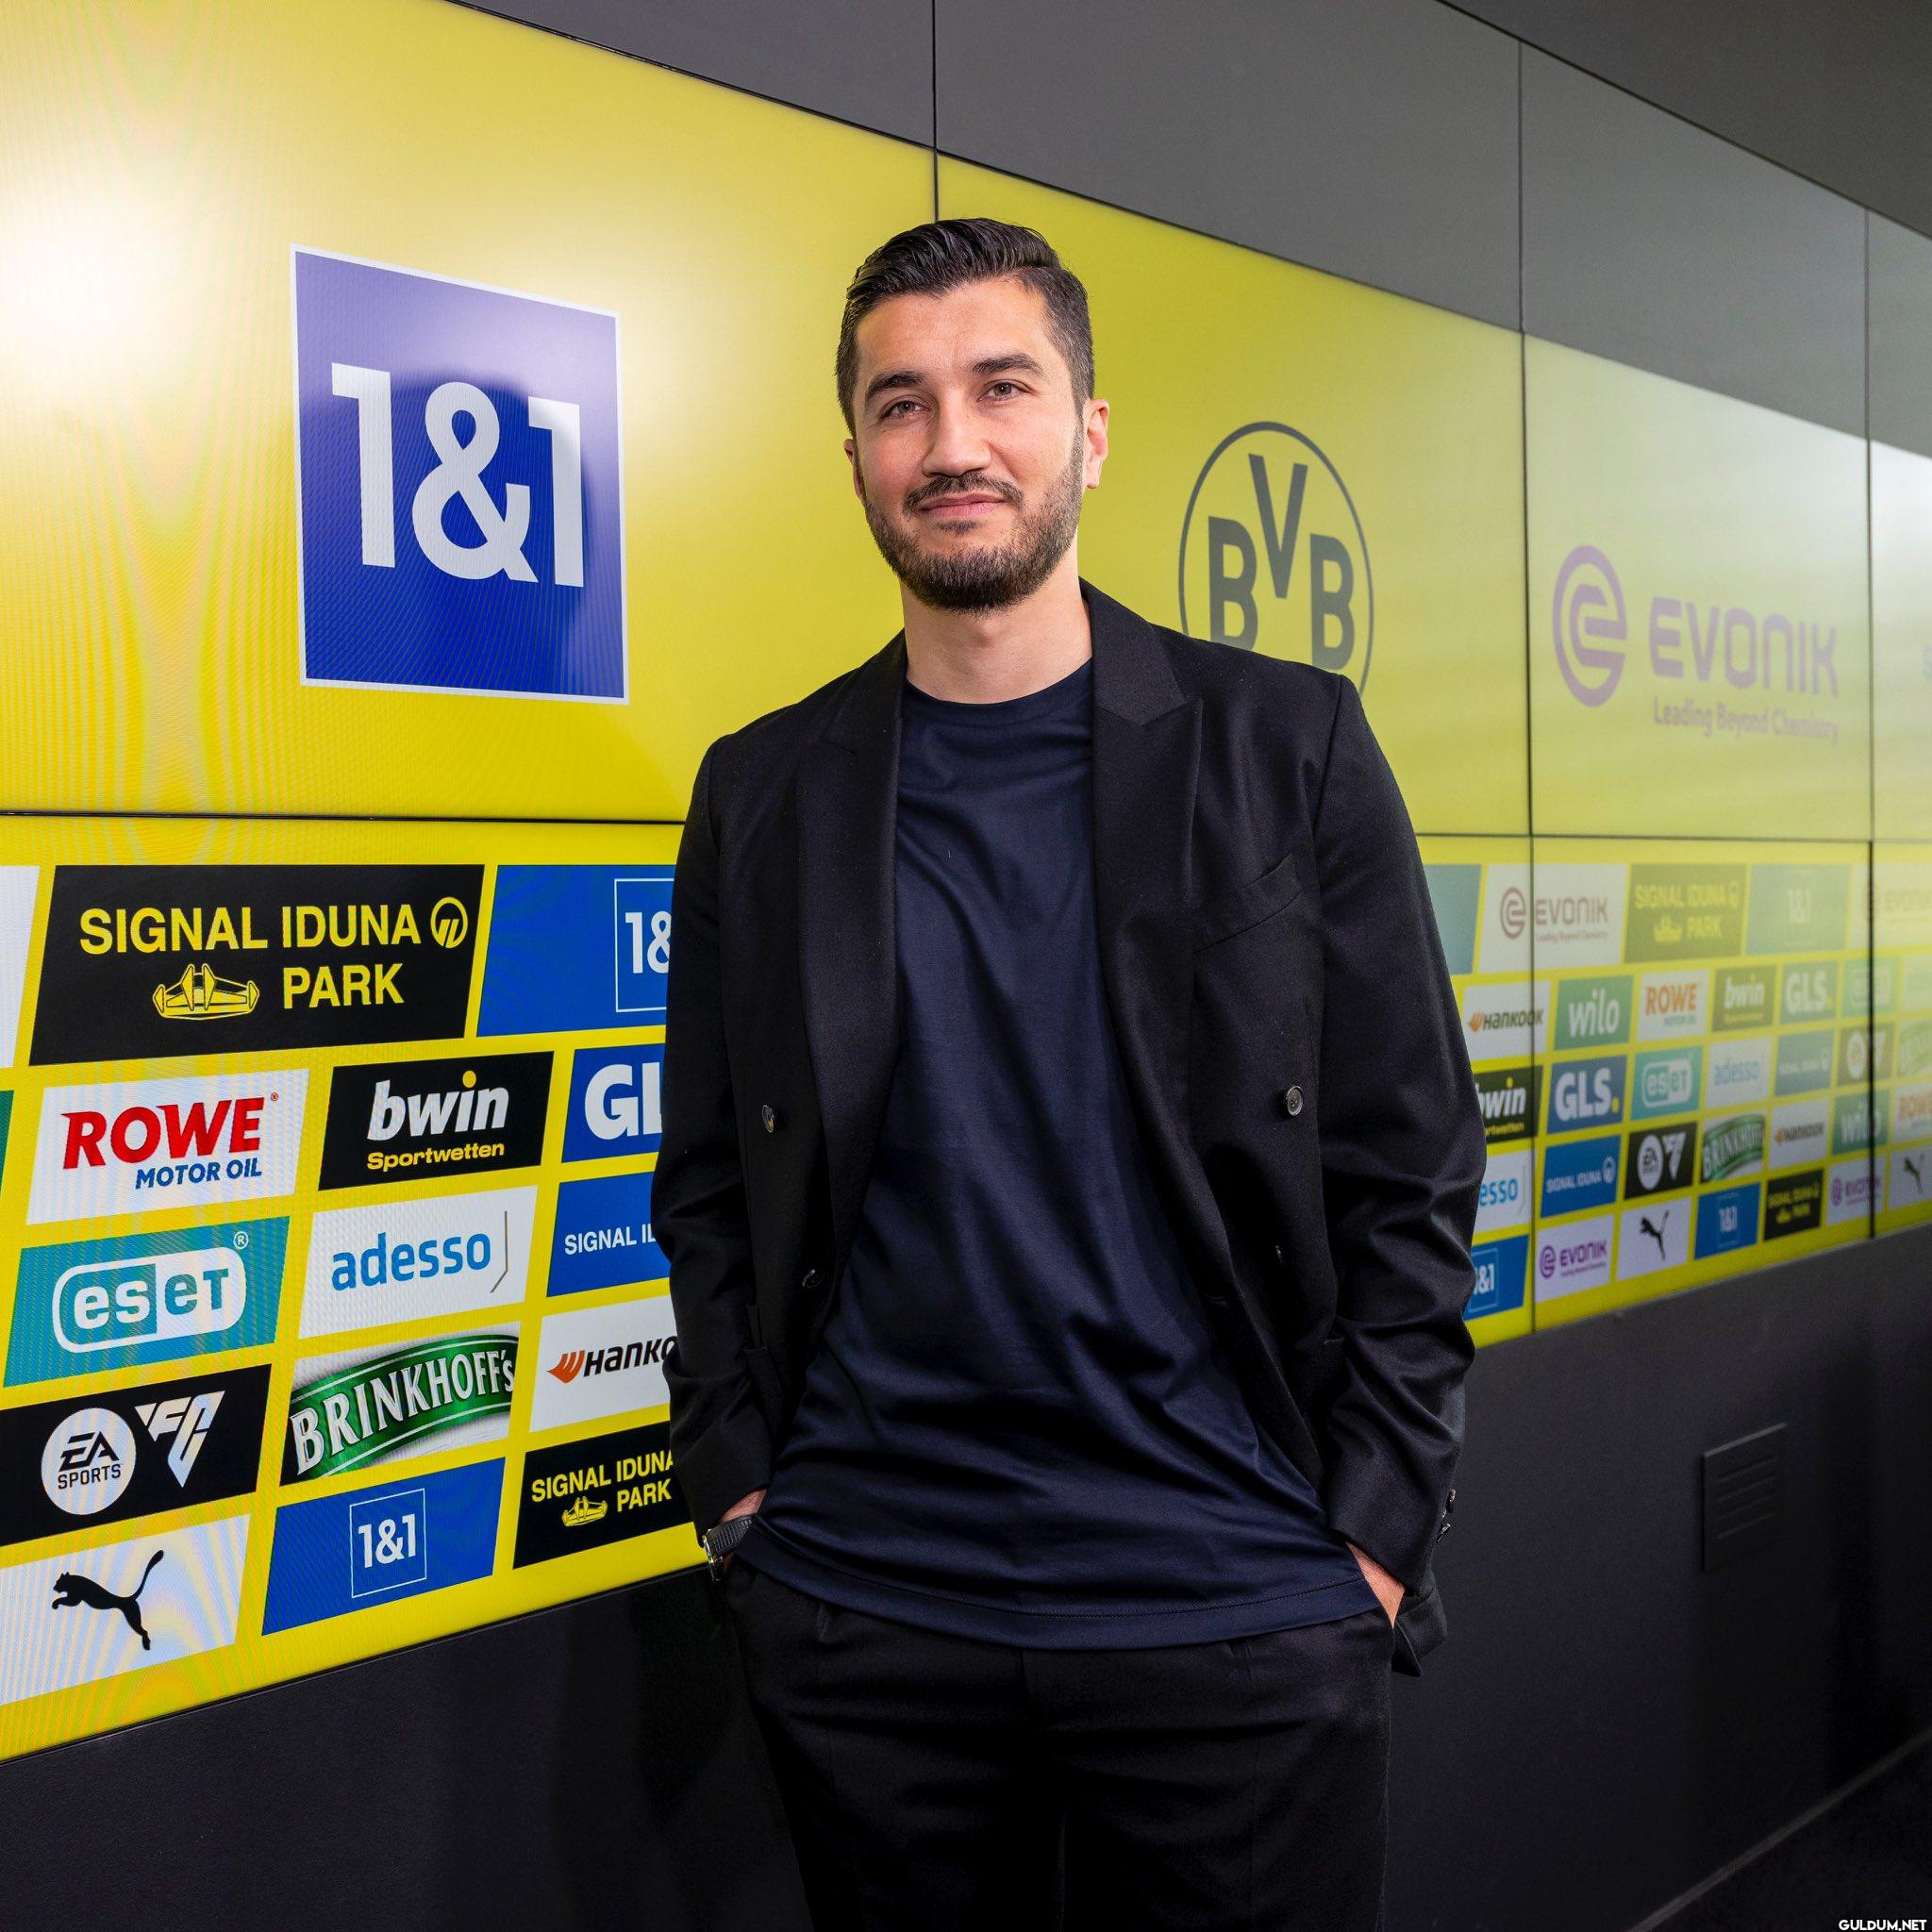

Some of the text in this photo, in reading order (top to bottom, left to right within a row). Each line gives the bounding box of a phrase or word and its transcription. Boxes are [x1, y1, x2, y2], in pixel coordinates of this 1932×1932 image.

[332, 362, 584, 587] 1&1
[1208, 453, 1355, 671] BVB
[1649, 596, 1839, 697] EVONIK
[80, 904, 422, 955] SIGNAL IDUNA
[1535, 897, 1607, 924] EVONIK
[625, 910, 672, 974] 1&
[283, 963, 404, 1009] PARK
[1645, 983, 1697, 1015] ROWE
[1724, 973, 1765, 1009] bwin
[1568, 989, 1621, 1038] wilo
[367, 1070, 509, 1141] bwin
[584, 1061, 663, 1140] GL
[61, 1096, 265, 1170] ROWE
[136, 1158, 262, 1189] MOTOR OIL
[367, 1142, 505, 1173] Sportwetten
[1479, 1177, 1519, 1207] esso
[331, 1232, 491, 1291] adesso
[564, 1225, 637, 1256] SIGNAL
[1559, 1240, 1607, 1266] EVONIK
[1474, 1263, 1495, 1295] &1
[58, 1431, 120, 1473] EA
[58, 1463, 122, 1490] SPORTS
[531, 1464, 611, 1503] SIGNAL
[617, 1478, 672, 1512] PARK
[358, 1513, 416, 1568] 1&1
